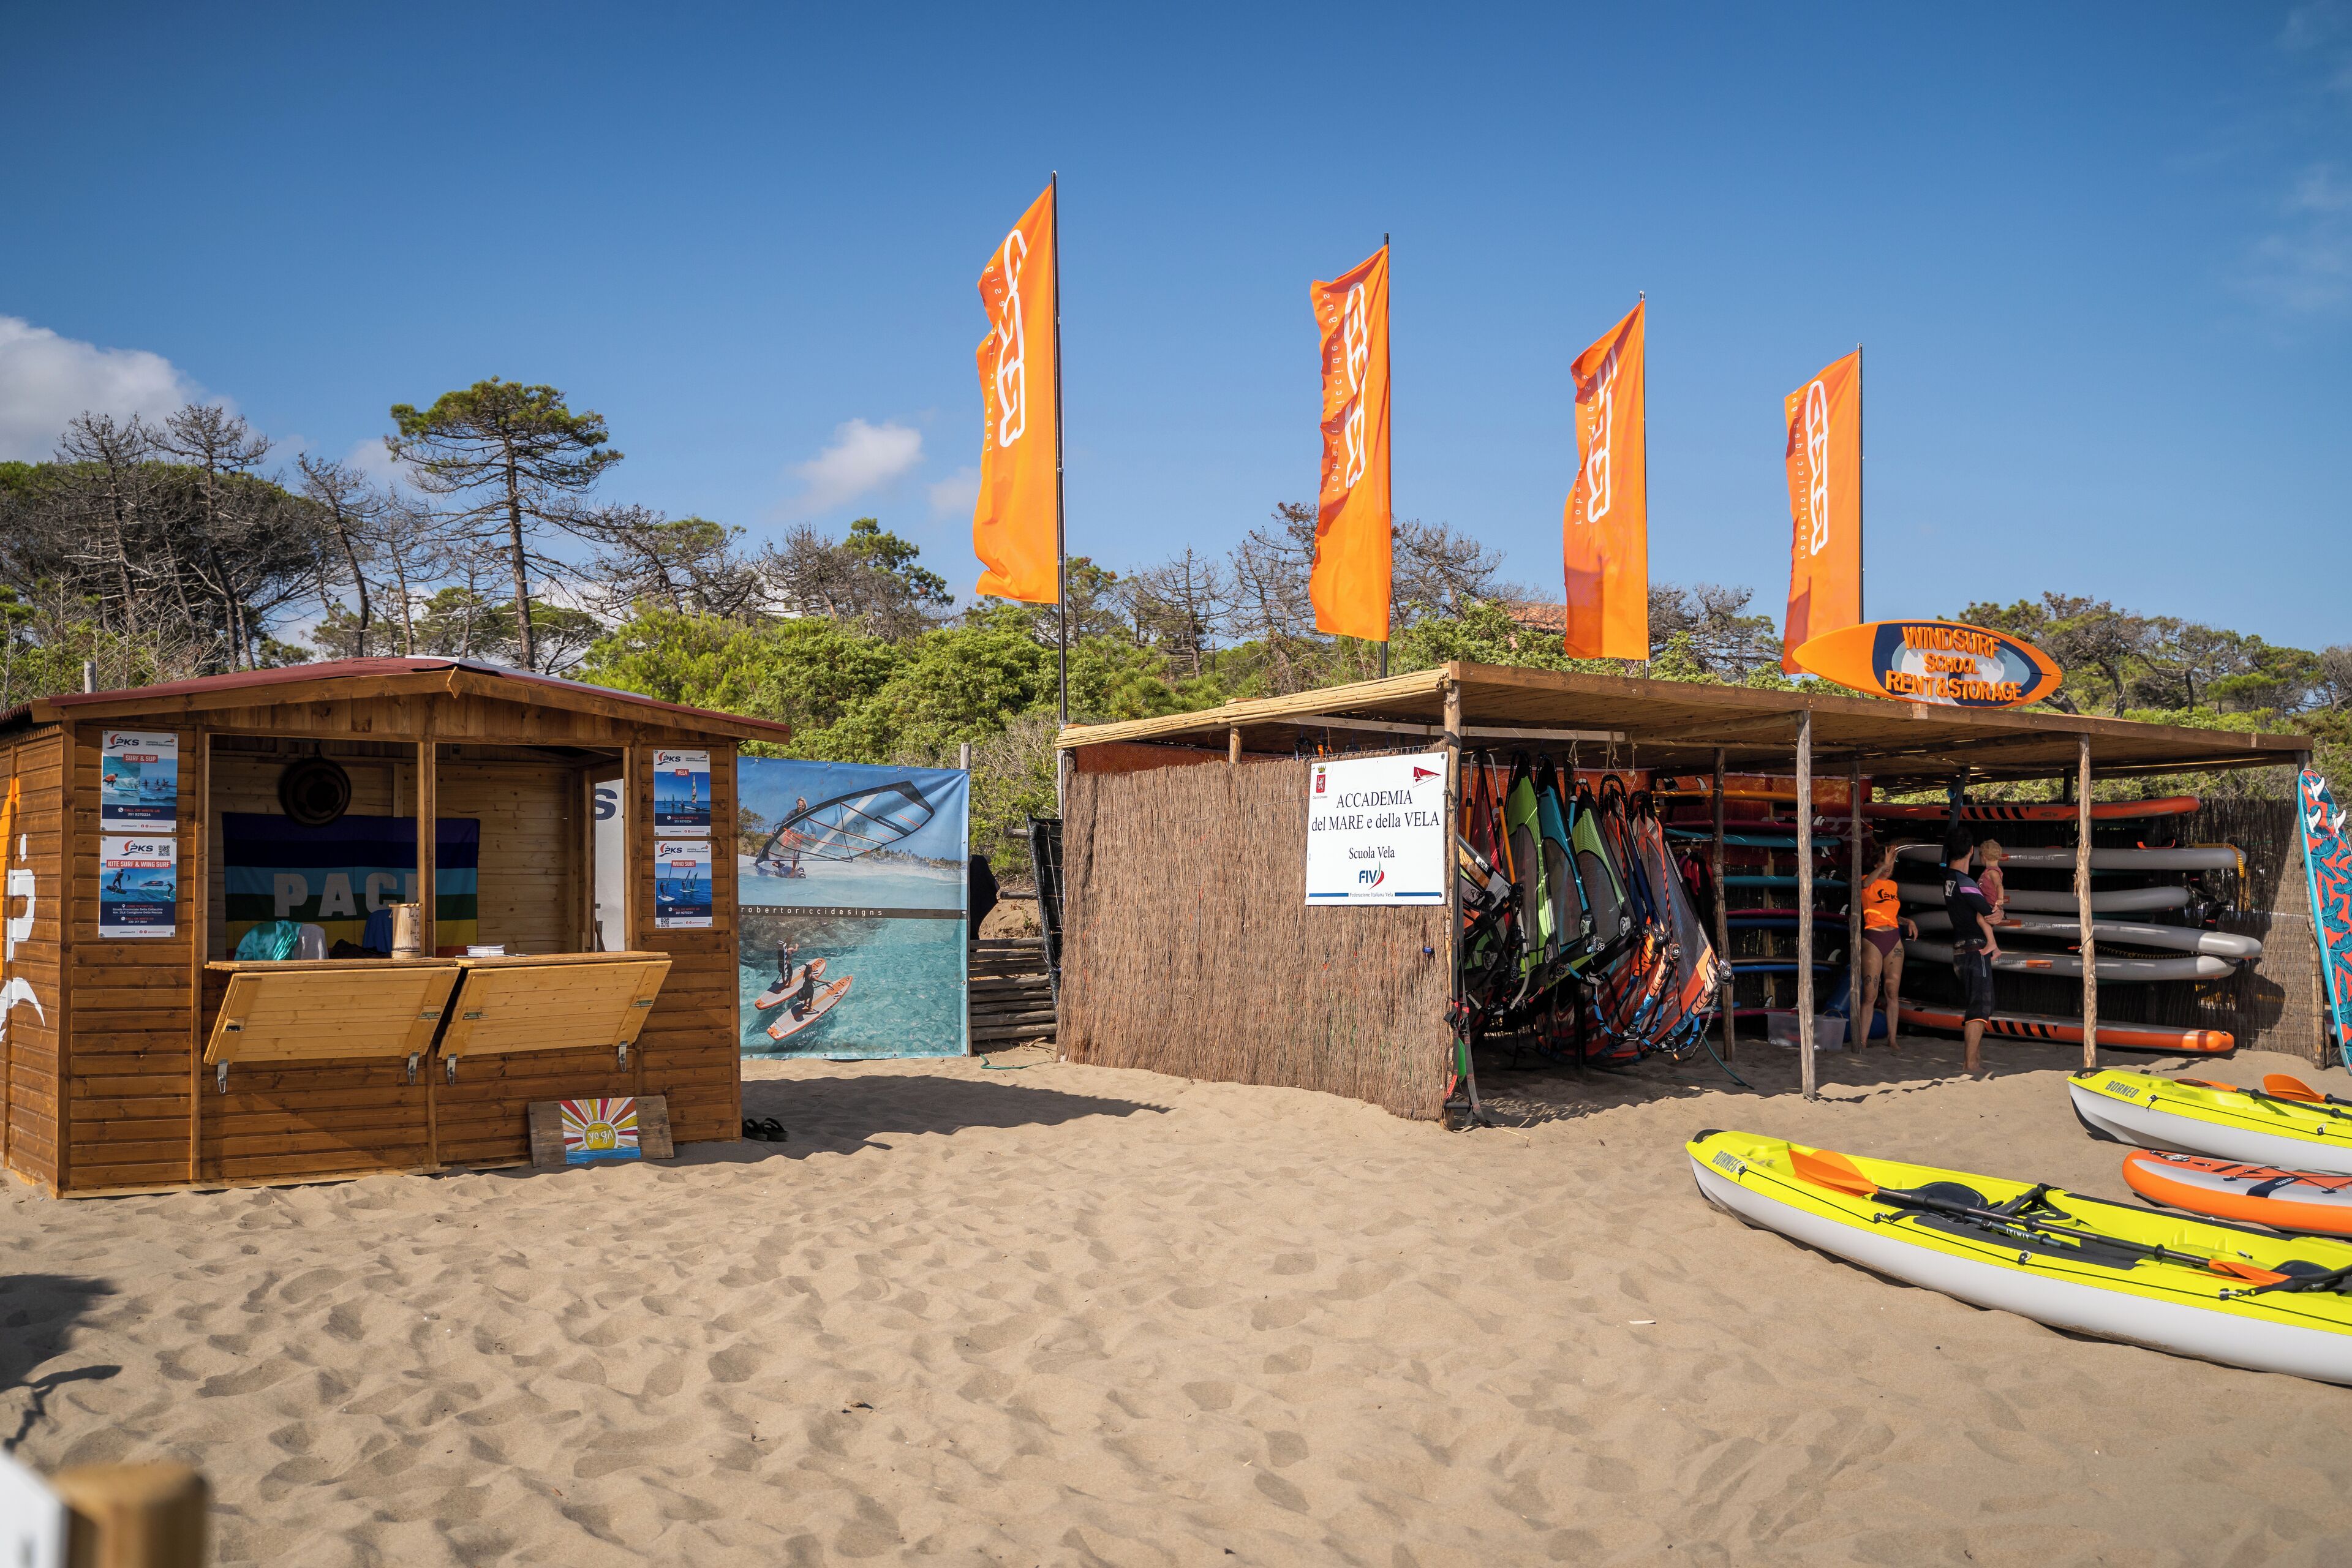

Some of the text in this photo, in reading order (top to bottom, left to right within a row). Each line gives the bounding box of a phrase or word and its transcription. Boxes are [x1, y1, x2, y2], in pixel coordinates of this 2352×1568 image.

[1902, 626, 2000, 658] WINDSURF
[1924, 653, 1980, 674] SCHOOL
[116, 737, 140, 746] PKS
[1336, 790, 1413, 808] ACCADEMIA
[1312, 811, 1440, 831] del MARE e della VELA
[1349, 845, 1395, 859] Scuola Vela
[1359, 870, 1378, 883] FIV
[741, 906, 883, 917] robertoriccidesigns
[2105, 1080, 2140, 1098] BORNEO
[2006, 1228, 2029, 1240] ITIWIT
